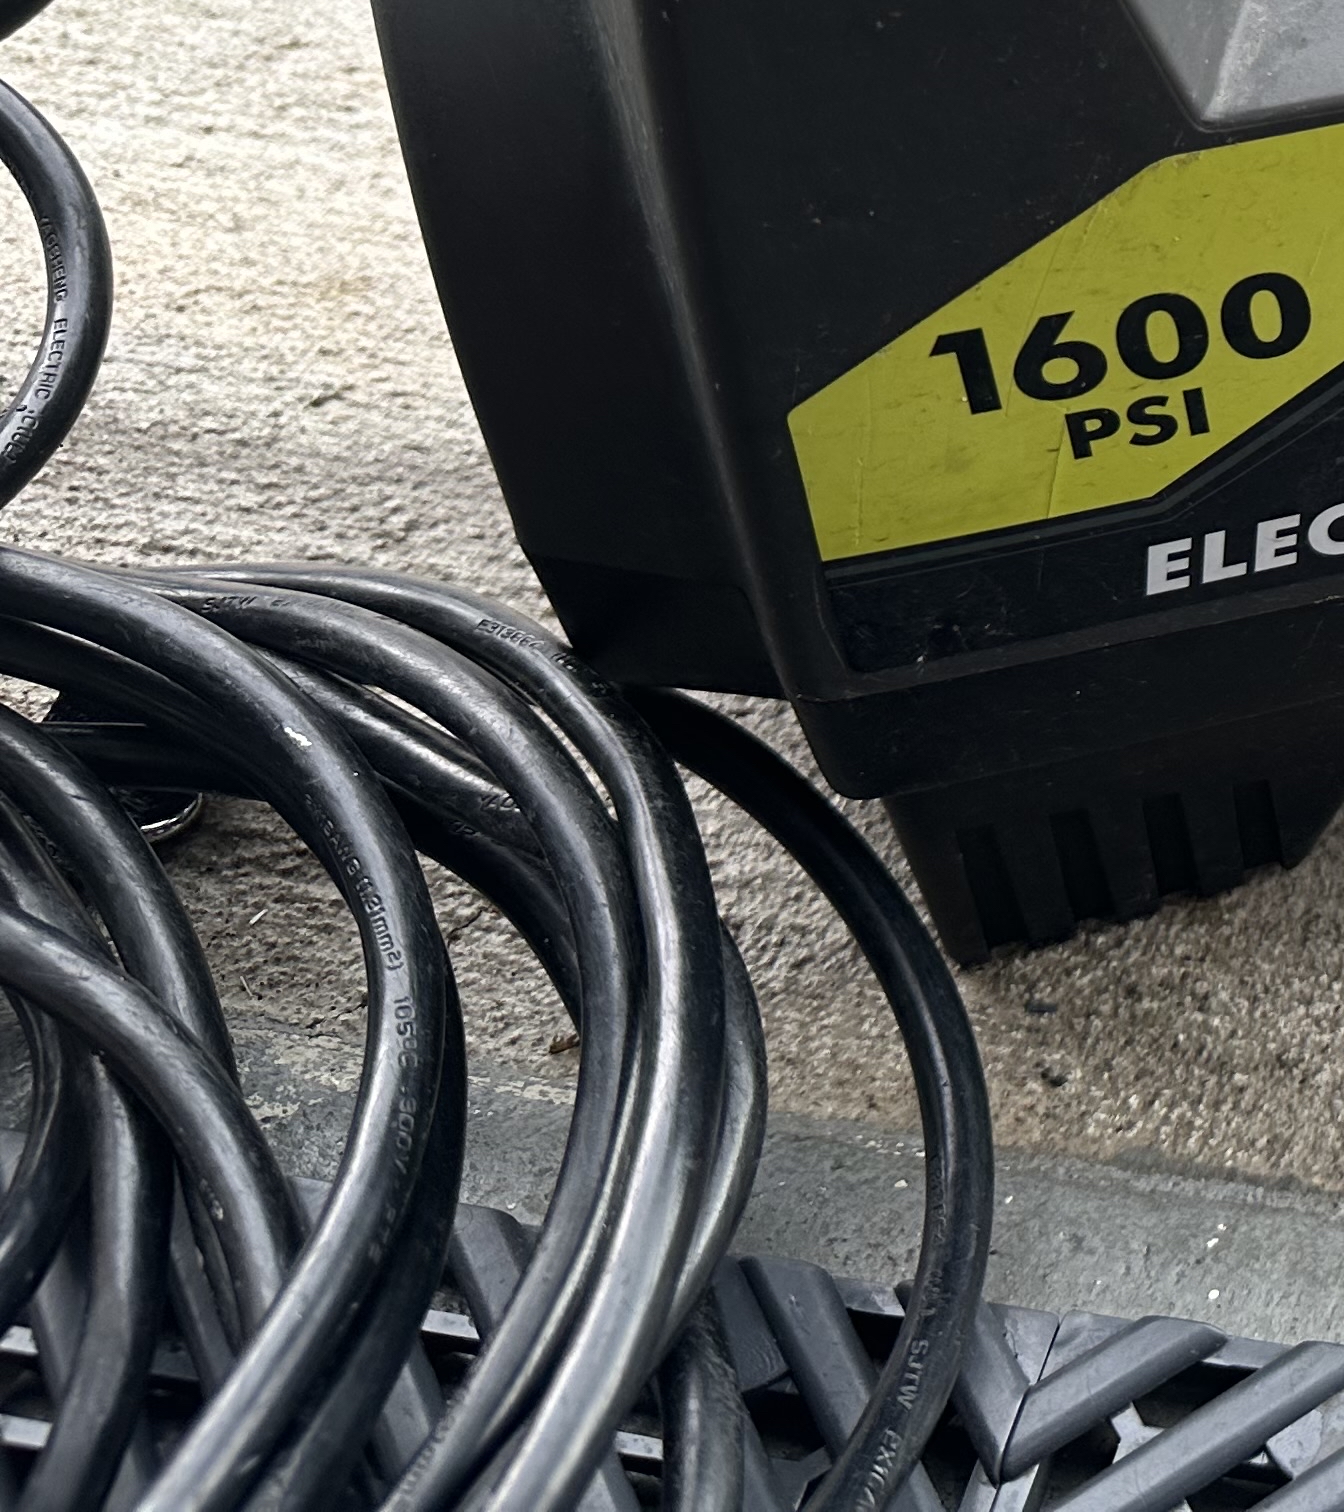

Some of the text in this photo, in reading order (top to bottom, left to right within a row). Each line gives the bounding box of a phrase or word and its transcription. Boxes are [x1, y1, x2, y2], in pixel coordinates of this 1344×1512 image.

[35, 318, 68, 399] ELECTRIC
[928, 271, 1312, 416] 1600
[1064, 387, 1212, 460] PSI
[896, 1337, 929, 1410] SJTW
